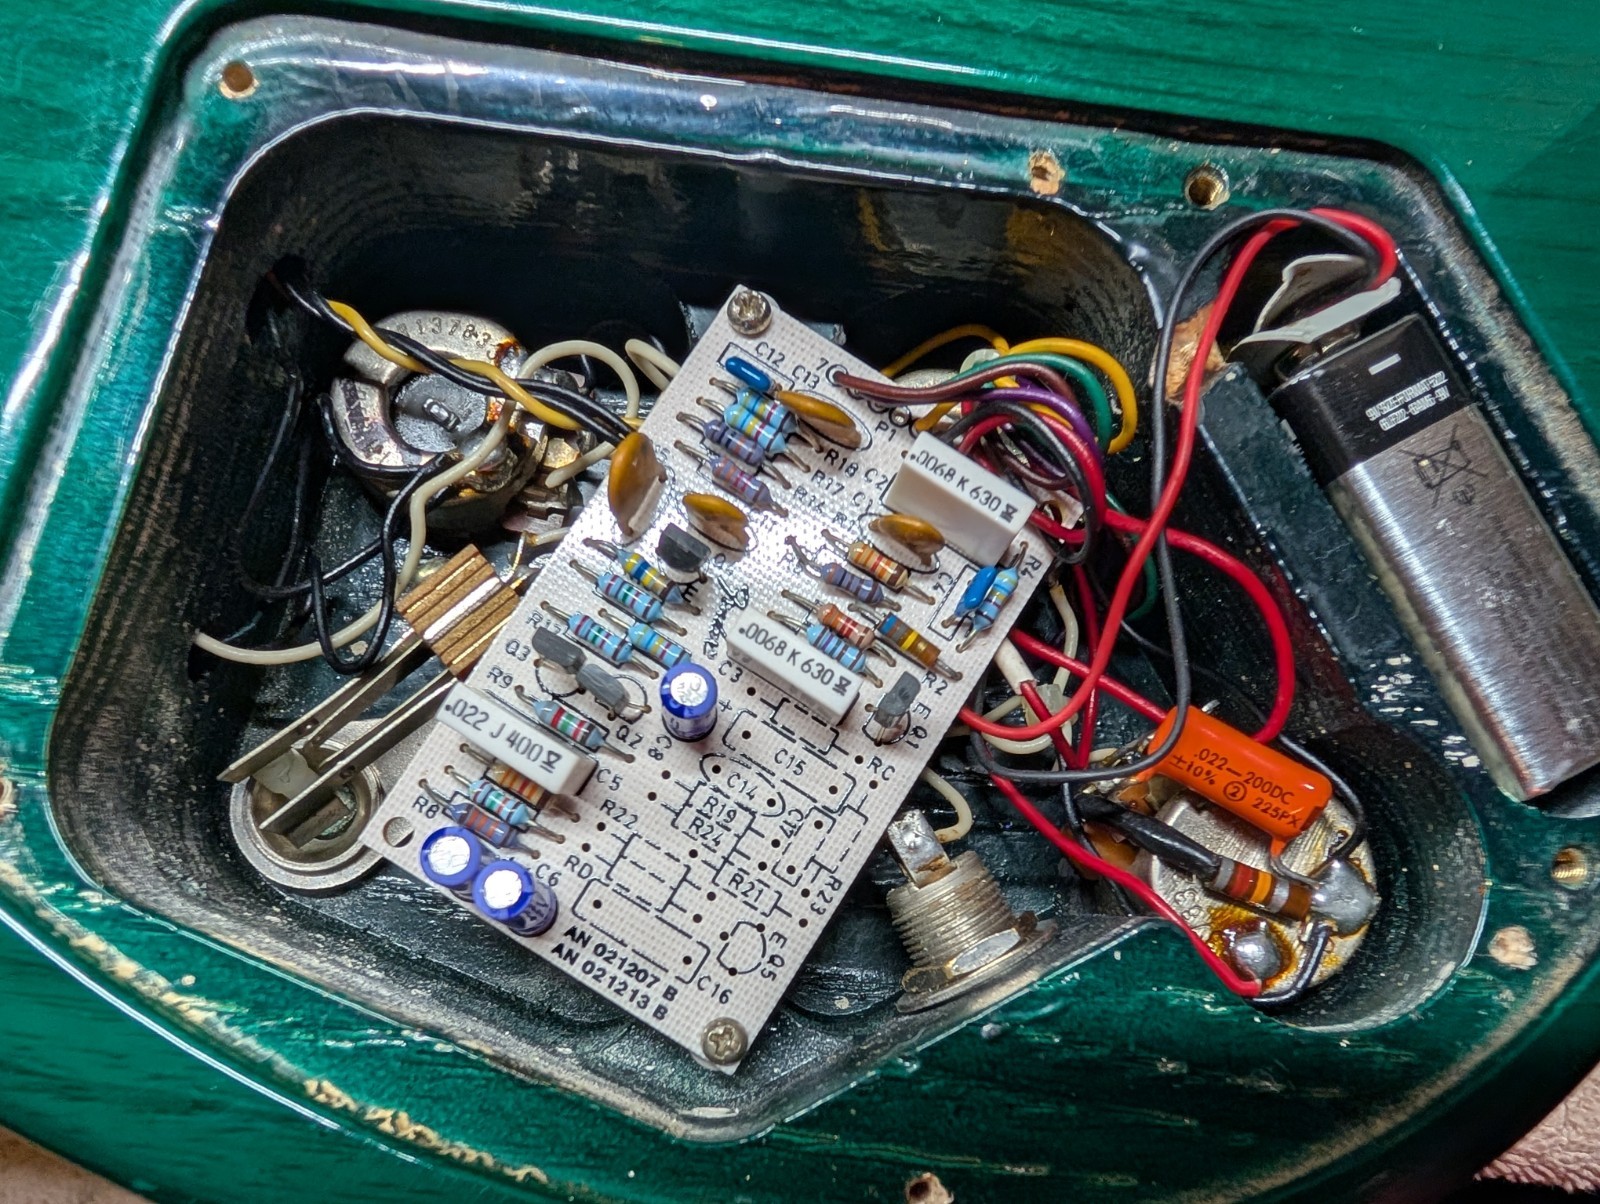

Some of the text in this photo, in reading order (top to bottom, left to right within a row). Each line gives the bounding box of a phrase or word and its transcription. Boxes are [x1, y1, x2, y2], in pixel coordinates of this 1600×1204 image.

[755, 341, 786, 368] C12
[792, 365, 820, 390] C13
[875, 420, 897, 442] P1
[824, 448, 859, 478] R18
[811, 469, 845, 495] R17
[864, 468, 888, 490] C2
[909, 450, 1001, 512] .0068 K 630
[852, 491, 873, 514] C1
[1020, 555, 1043, 579] R4
[505, 638, 531, 662] Q3
[738, 623, 835, 686] .0068 K 630
[487, 665, 514, 689] R9
[718, 660, 743, 683] C3
[922, 670, 948, 696] R2
[912, 702, 932, 720] E
[445, 698, 544, 762] .022 J 400
[616, 725, 644, 749] Q2
[648, 734, 672, 761] C8
[774, 748, 806, 776] C15
[867, 756, 895, 781] RC
[596, 768, 623, 791] C5
[727, 772, 758, 800] C14
[1168, 754, 1216, 786] ±10%
[1252, 797, 1302, 828] 225PX
[412, 795, 439, 819] R8
[600, 799, 638, 829] R22
[703, 795, 737, 824] R19
[688, 816, 725, 847] R24
[779, 808, 804, 839] C17
[535, 863, 562, 887] C6
[563, 854, 594, 879] RD
[728, 872, 764, 903] R21
[810, 875, 843, 916] R23
[769, 931, 788, 949] E
[564, 925, 678, 1002] AN 021207 B
[760, 954, 785, 982] Q5
[551, 943, 669, 1021] AN 021213 B
[697, 975, 734, 1005] C16
